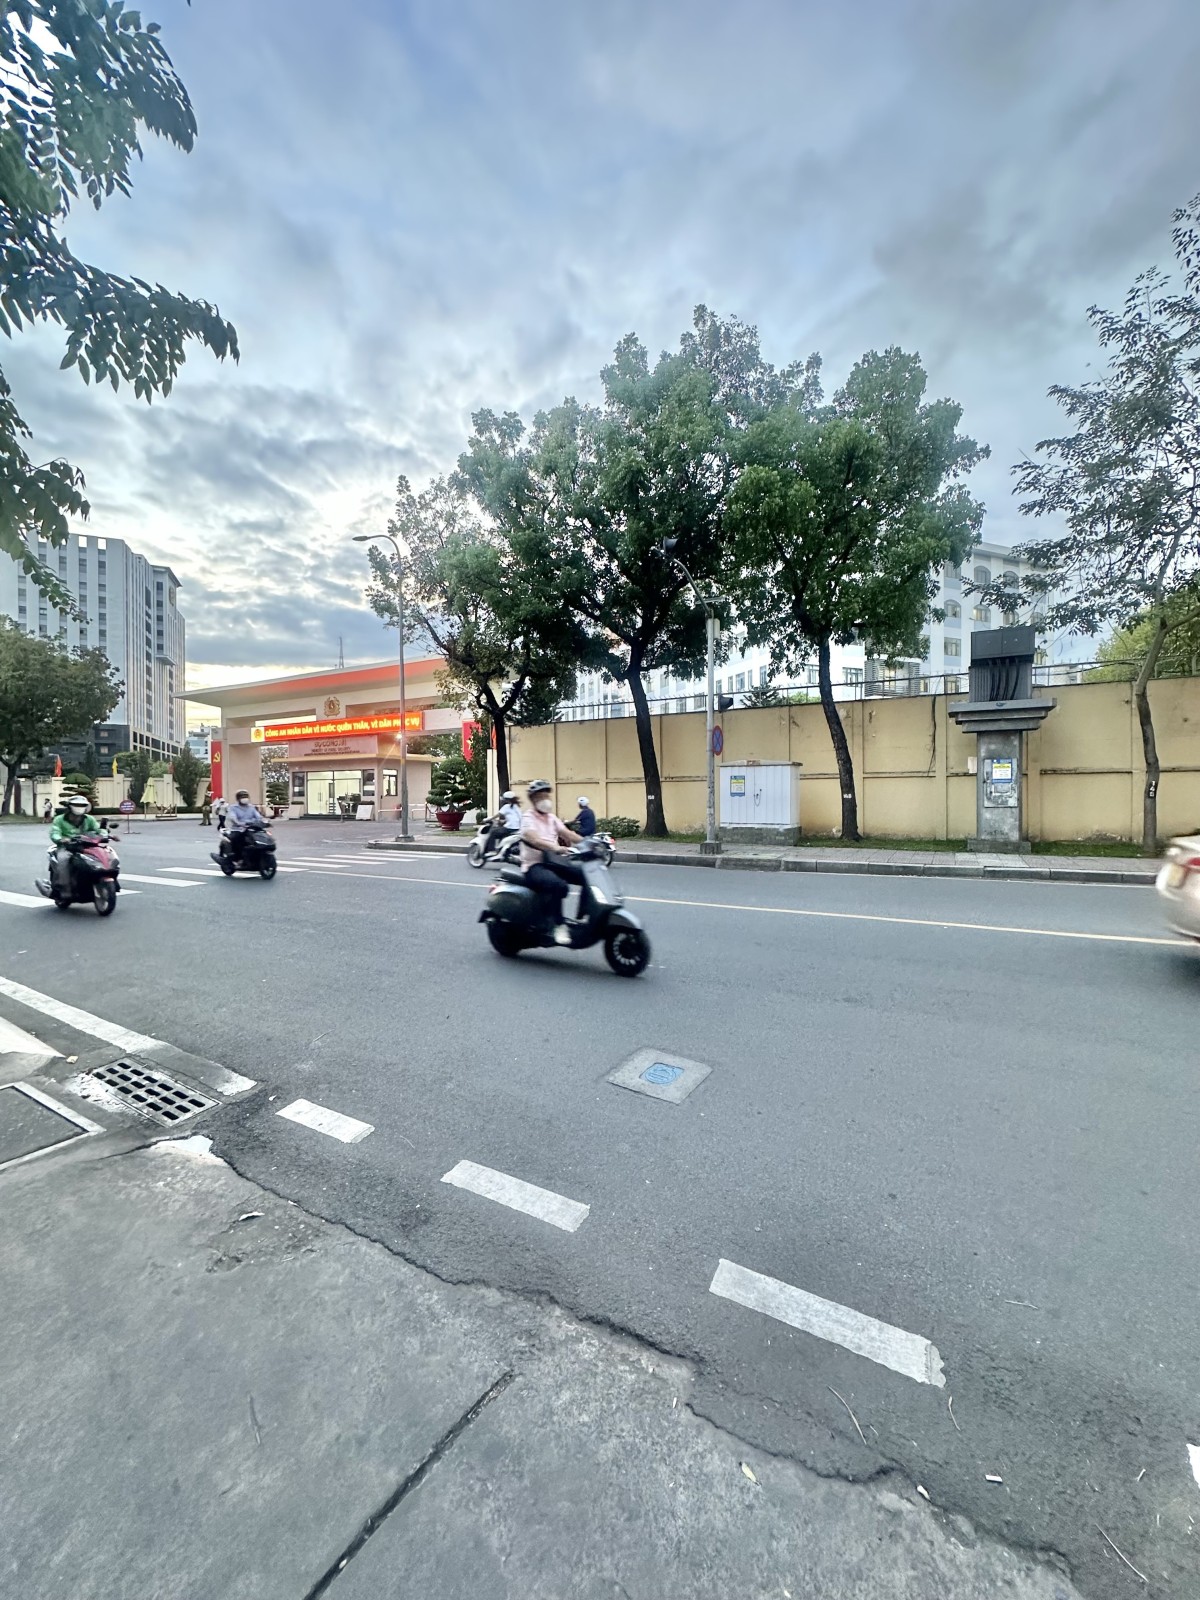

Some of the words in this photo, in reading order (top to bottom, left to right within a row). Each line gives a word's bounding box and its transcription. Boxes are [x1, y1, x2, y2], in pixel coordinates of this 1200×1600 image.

[265, 728, 279, 738] CÔNG
[279, 729, 287, 737] AN
[287, 727, 302, 736] NHÂN
[302, 725, 313, 735] DÂN
[314, 724, 320, 733] VÌ
[320, 722, 337, 732] NƯỚC
[336, 721, 353, 732] QUÊN
[371, 719, 379, 728] VÌ
[379, 718, 392, 727] DÂN
[392, 717, 410, 727] PHC
[410, 717, 420, 727] VỤ
